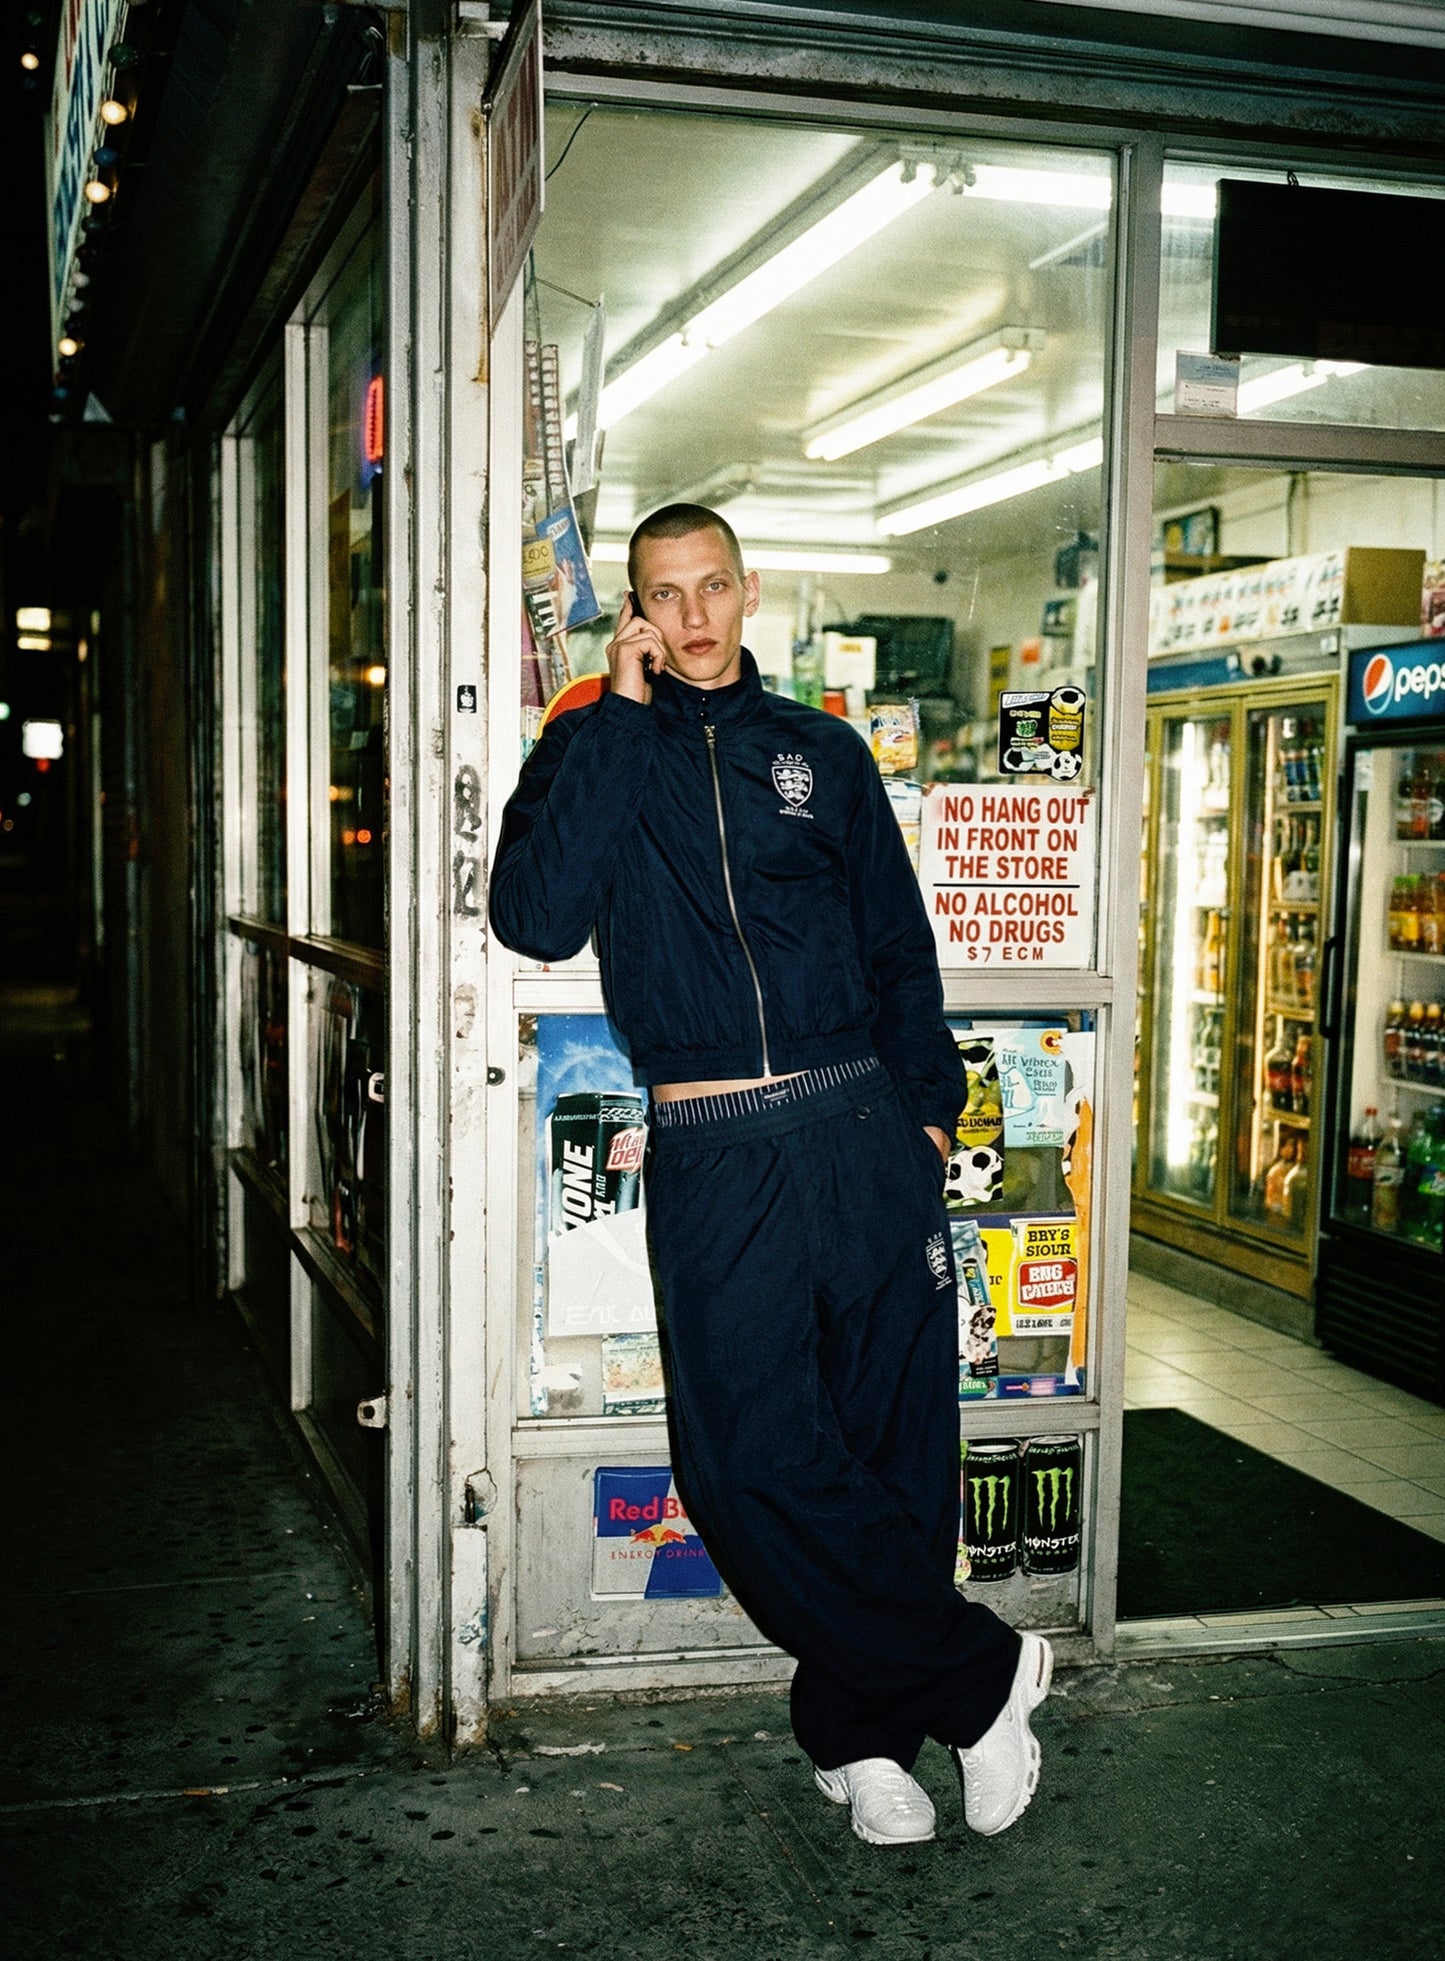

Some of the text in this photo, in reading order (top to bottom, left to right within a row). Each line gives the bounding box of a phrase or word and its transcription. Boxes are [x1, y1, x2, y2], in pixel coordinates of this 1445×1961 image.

[944, 796, 1090, 824] NO HANG OUT
[937, 827, 1077, 852] IN FRONT ON
[945, 855, 1068, 880] THE STORE
[935, 892, 1078, 917] NO ALCOHOL
[949, 919, 1065, 943] NO DRUGS
[1002, 946, 1044, 961] ECM
[608, 1496, 659, 1521] Red
